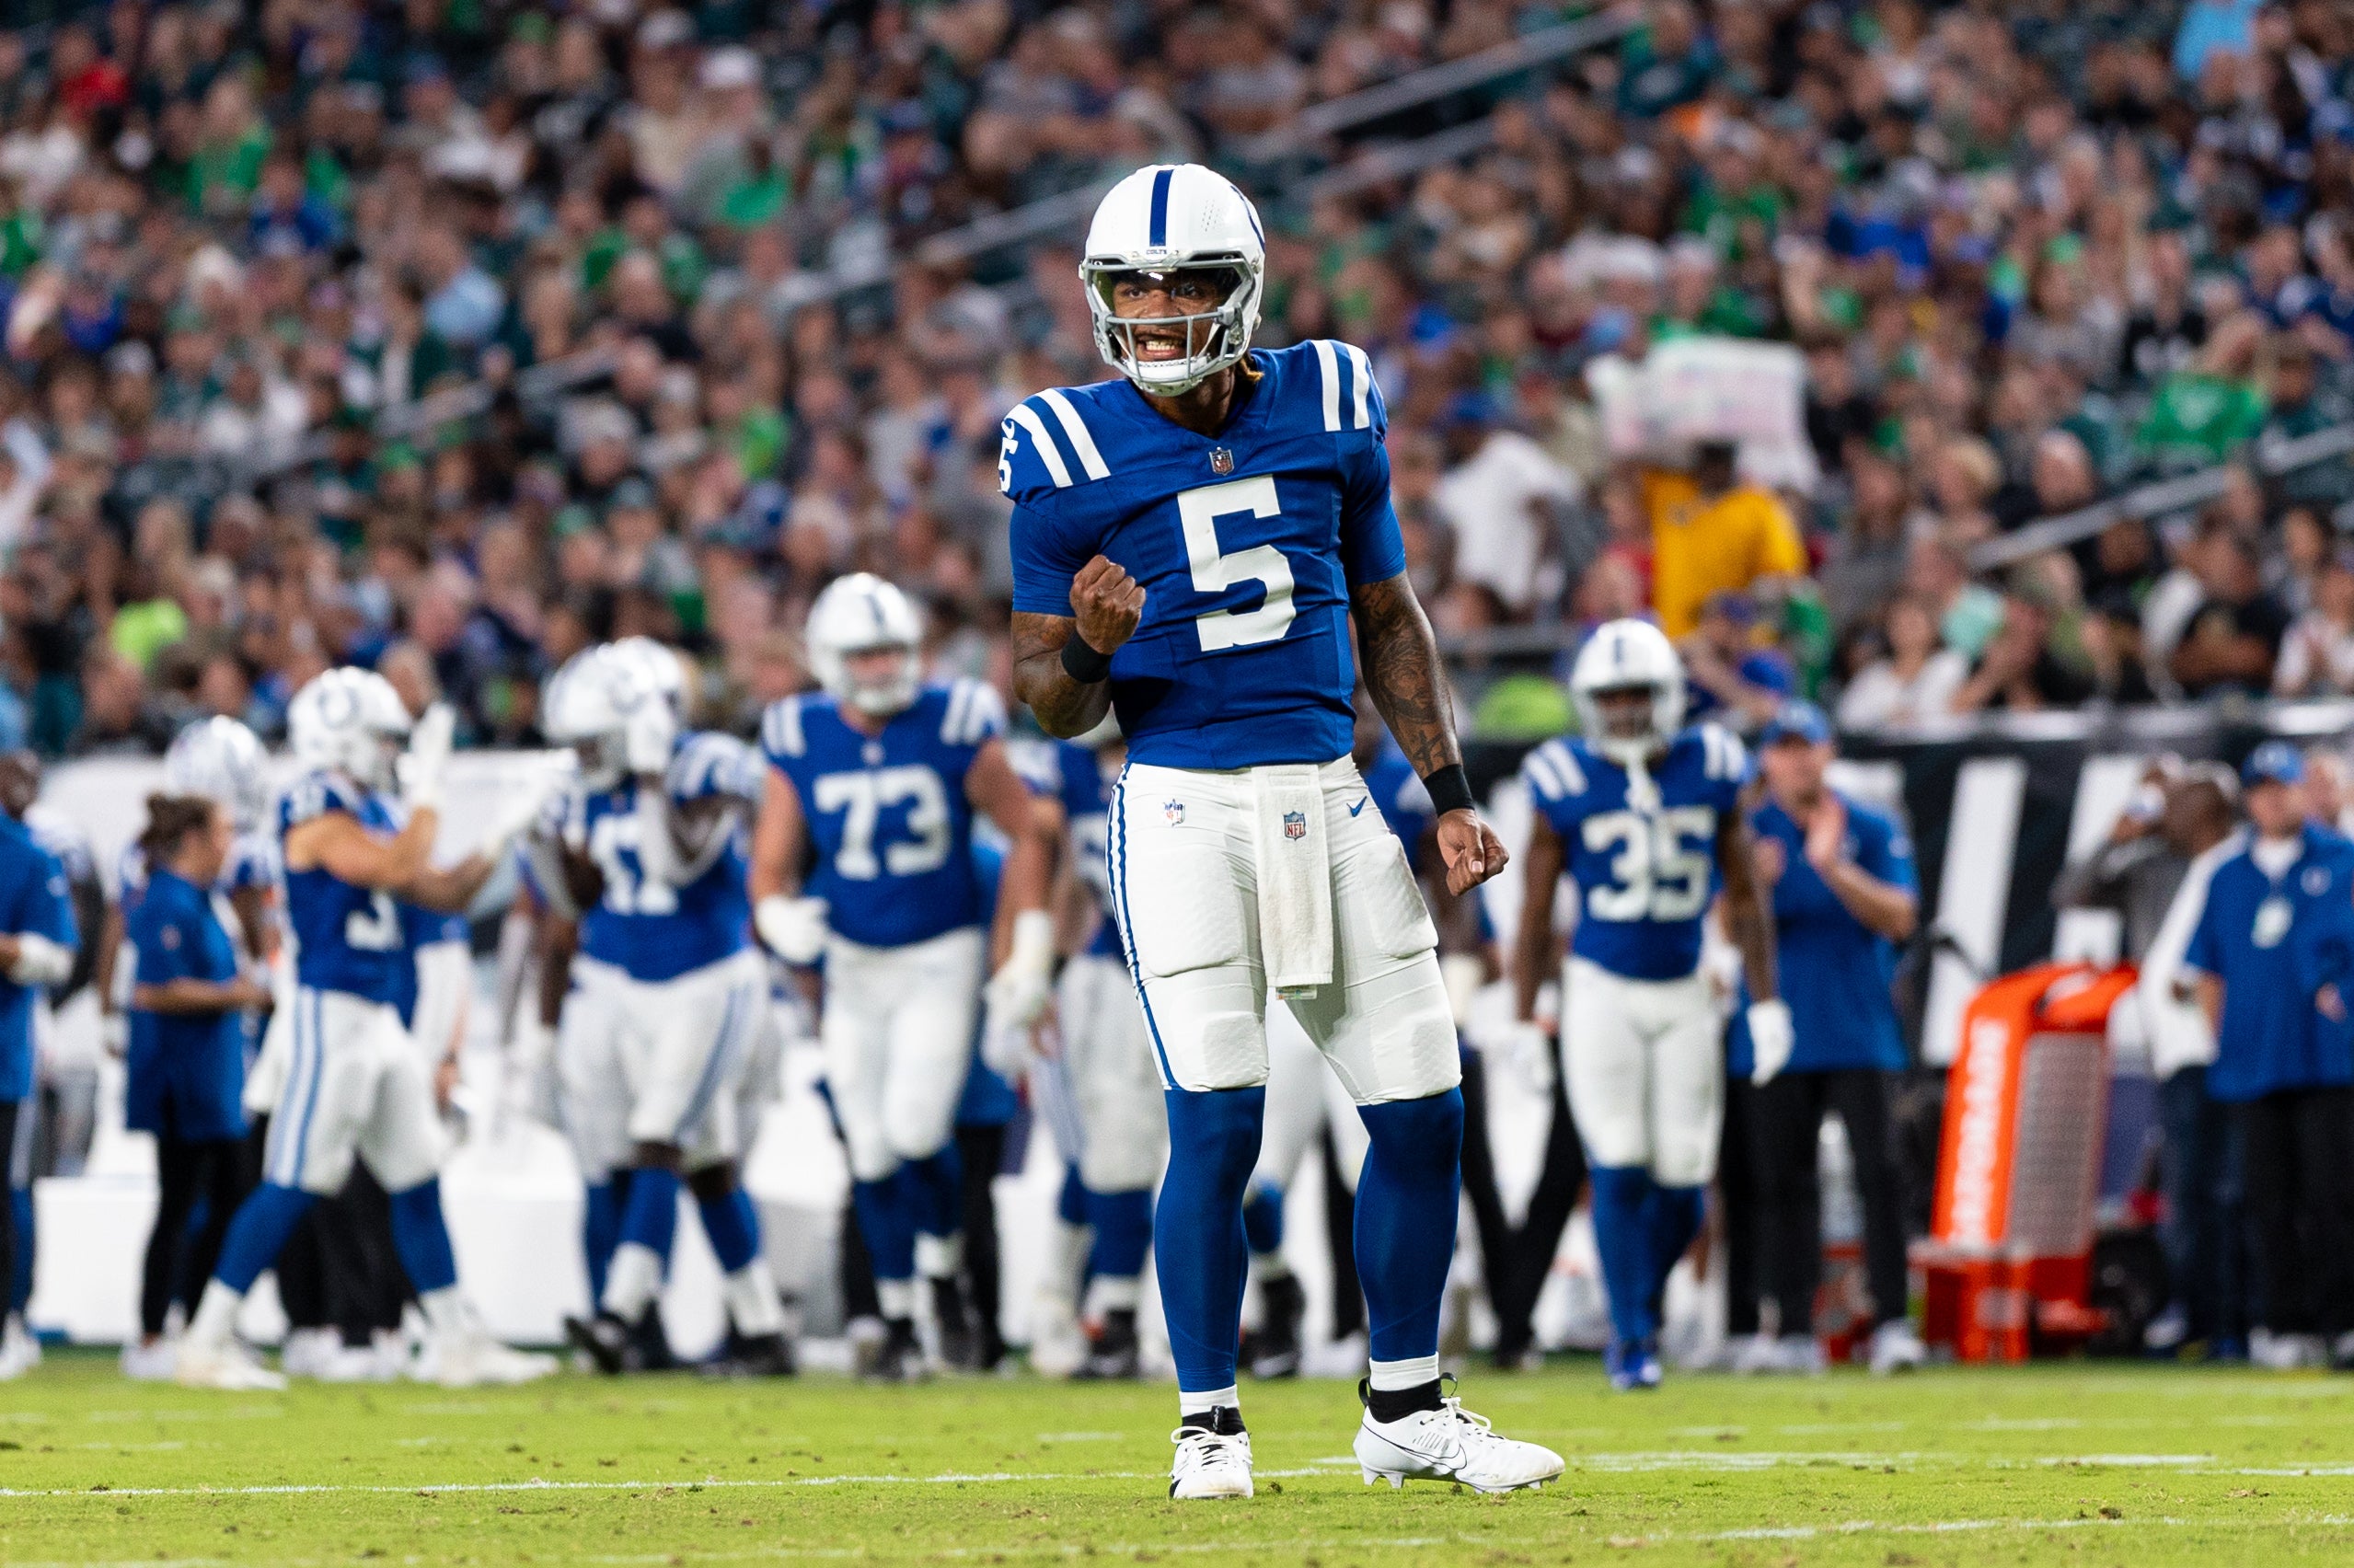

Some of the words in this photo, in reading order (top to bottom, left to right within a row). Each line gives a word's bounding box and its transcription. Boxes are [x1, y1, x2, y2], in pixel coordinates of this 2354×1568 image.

[1177, 474, 1297, 651] 5
[815, 765, 951, 881] 73
[1287, 824, 1304, 836] NFL
[1581, 806, 1715, 921] 35
